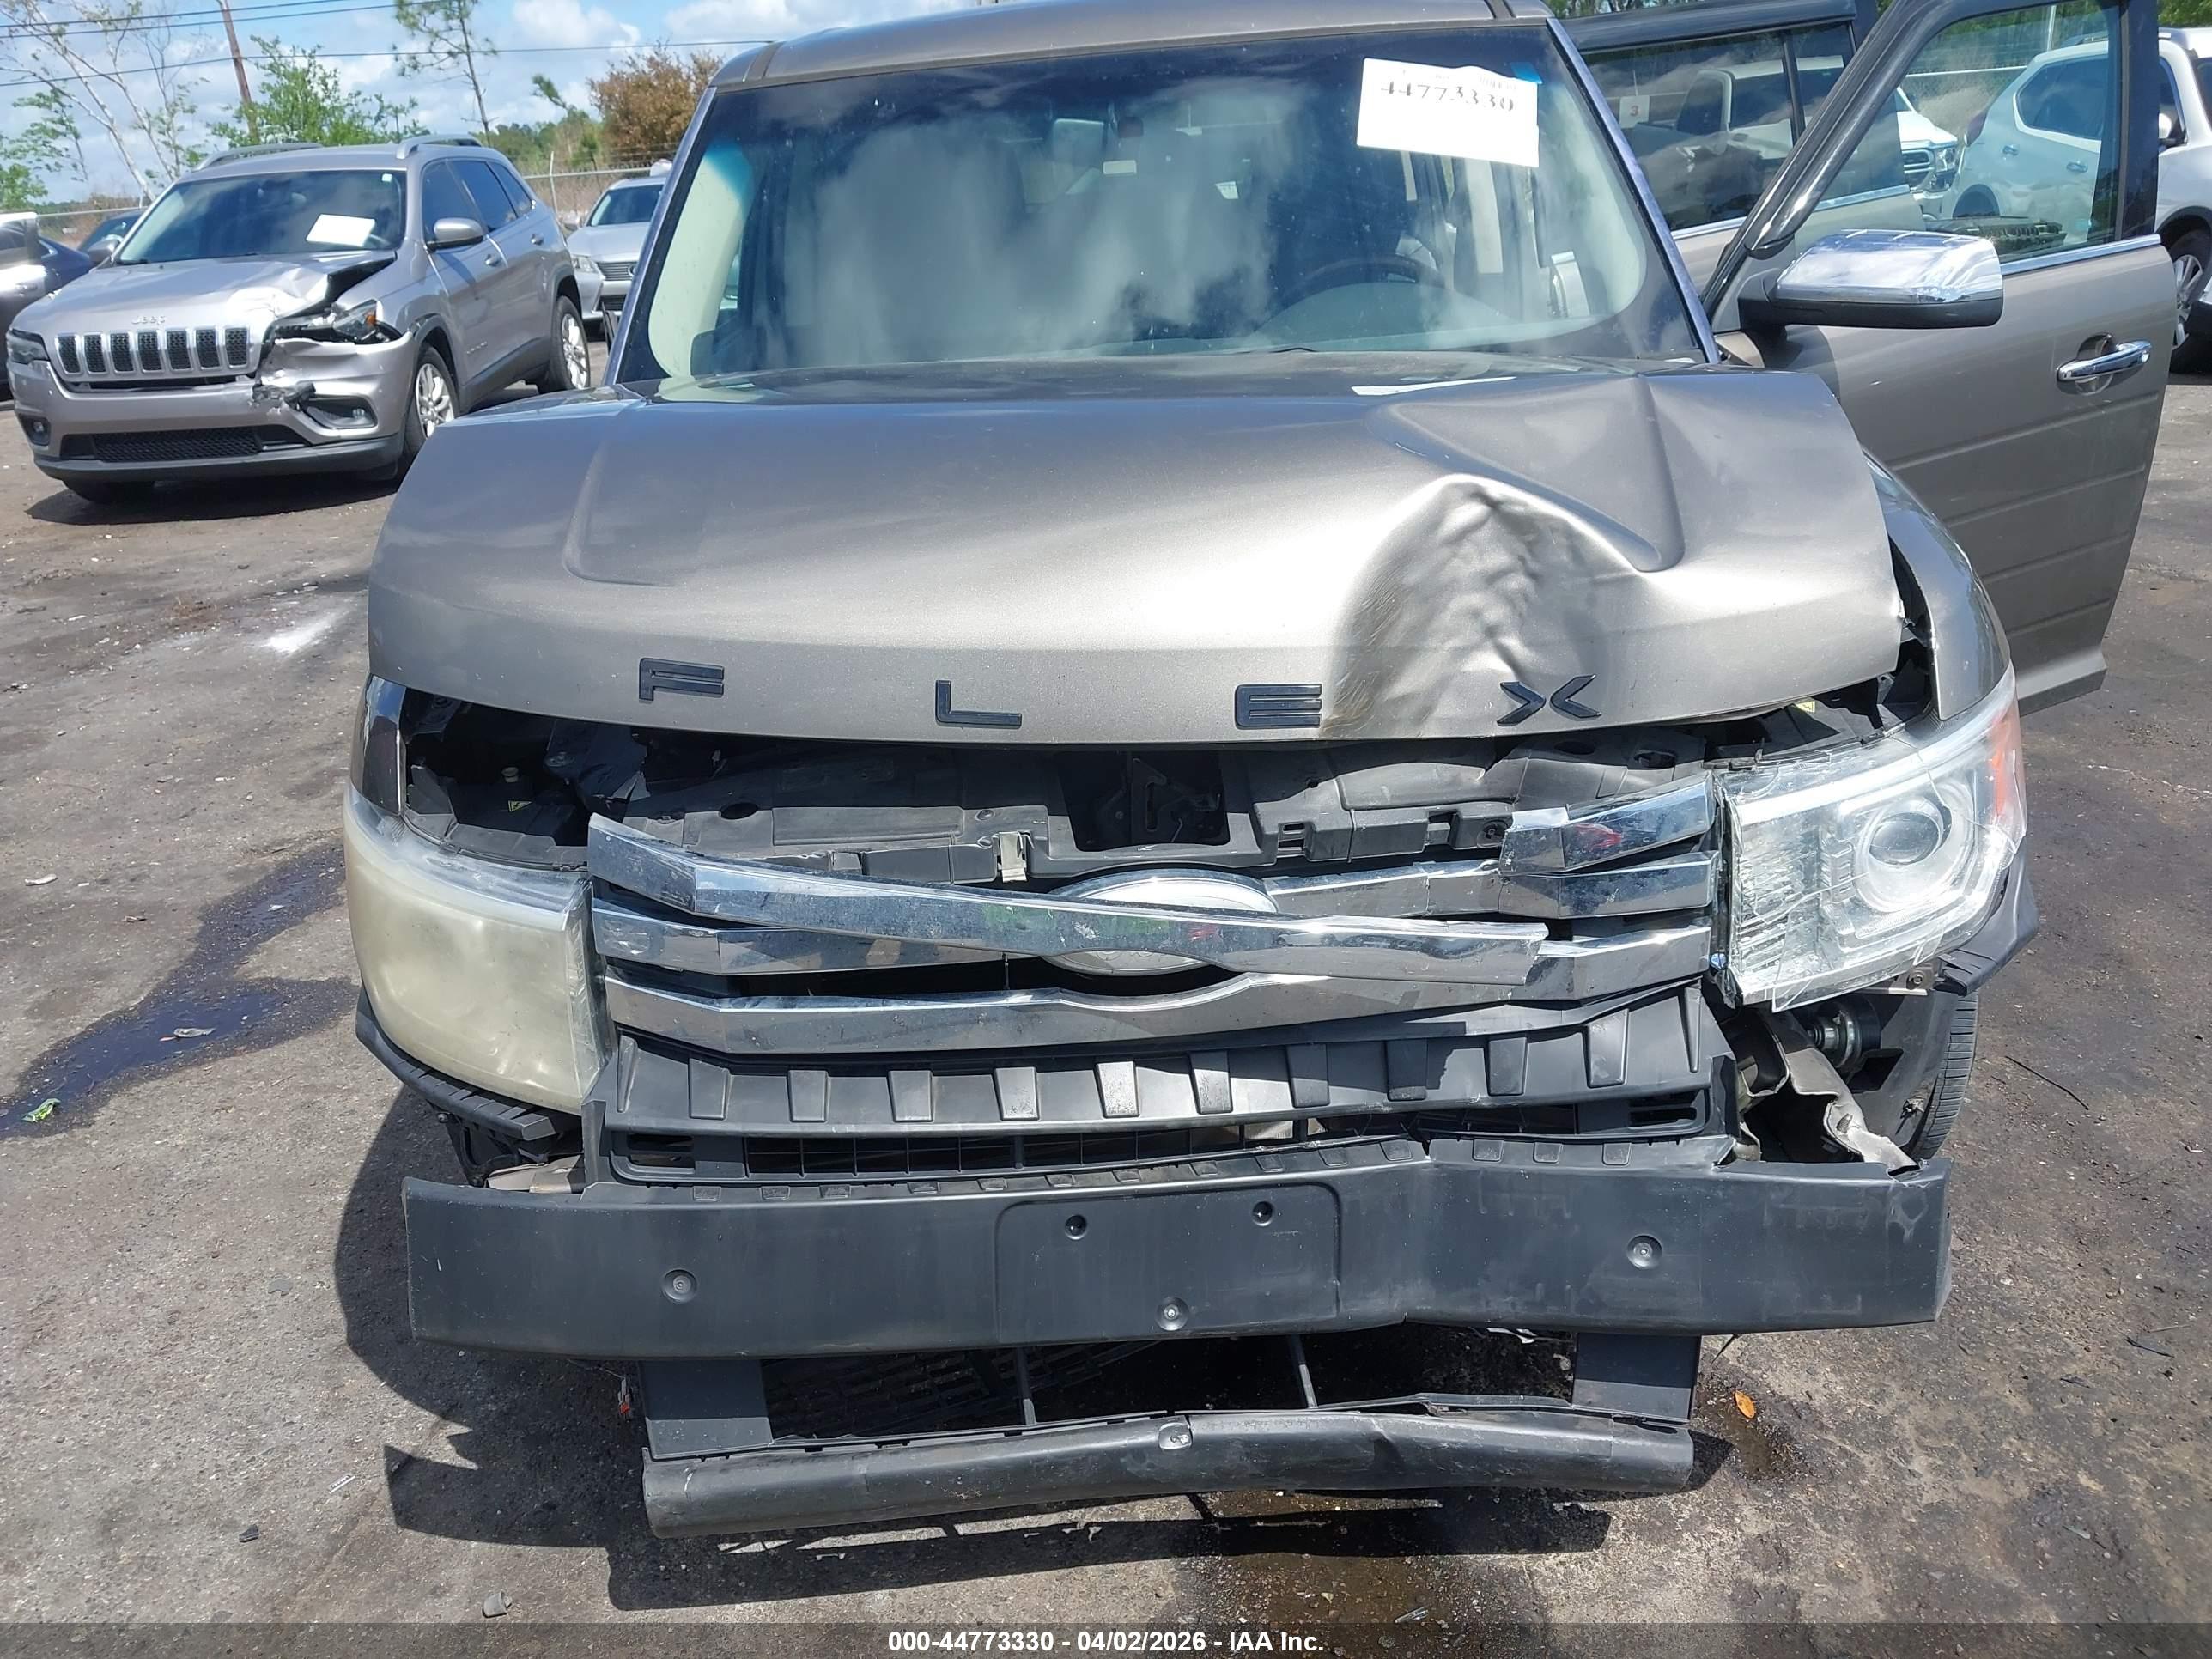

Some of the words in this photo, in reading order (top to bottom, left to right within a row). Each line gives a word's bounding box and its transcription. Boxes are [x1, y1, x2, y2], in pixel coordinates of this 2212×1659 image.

[1630, 105, 1639, 117] 3
[131, 315, 166, 326] Jeep
[639, 658, 1601, 729] FLEX
